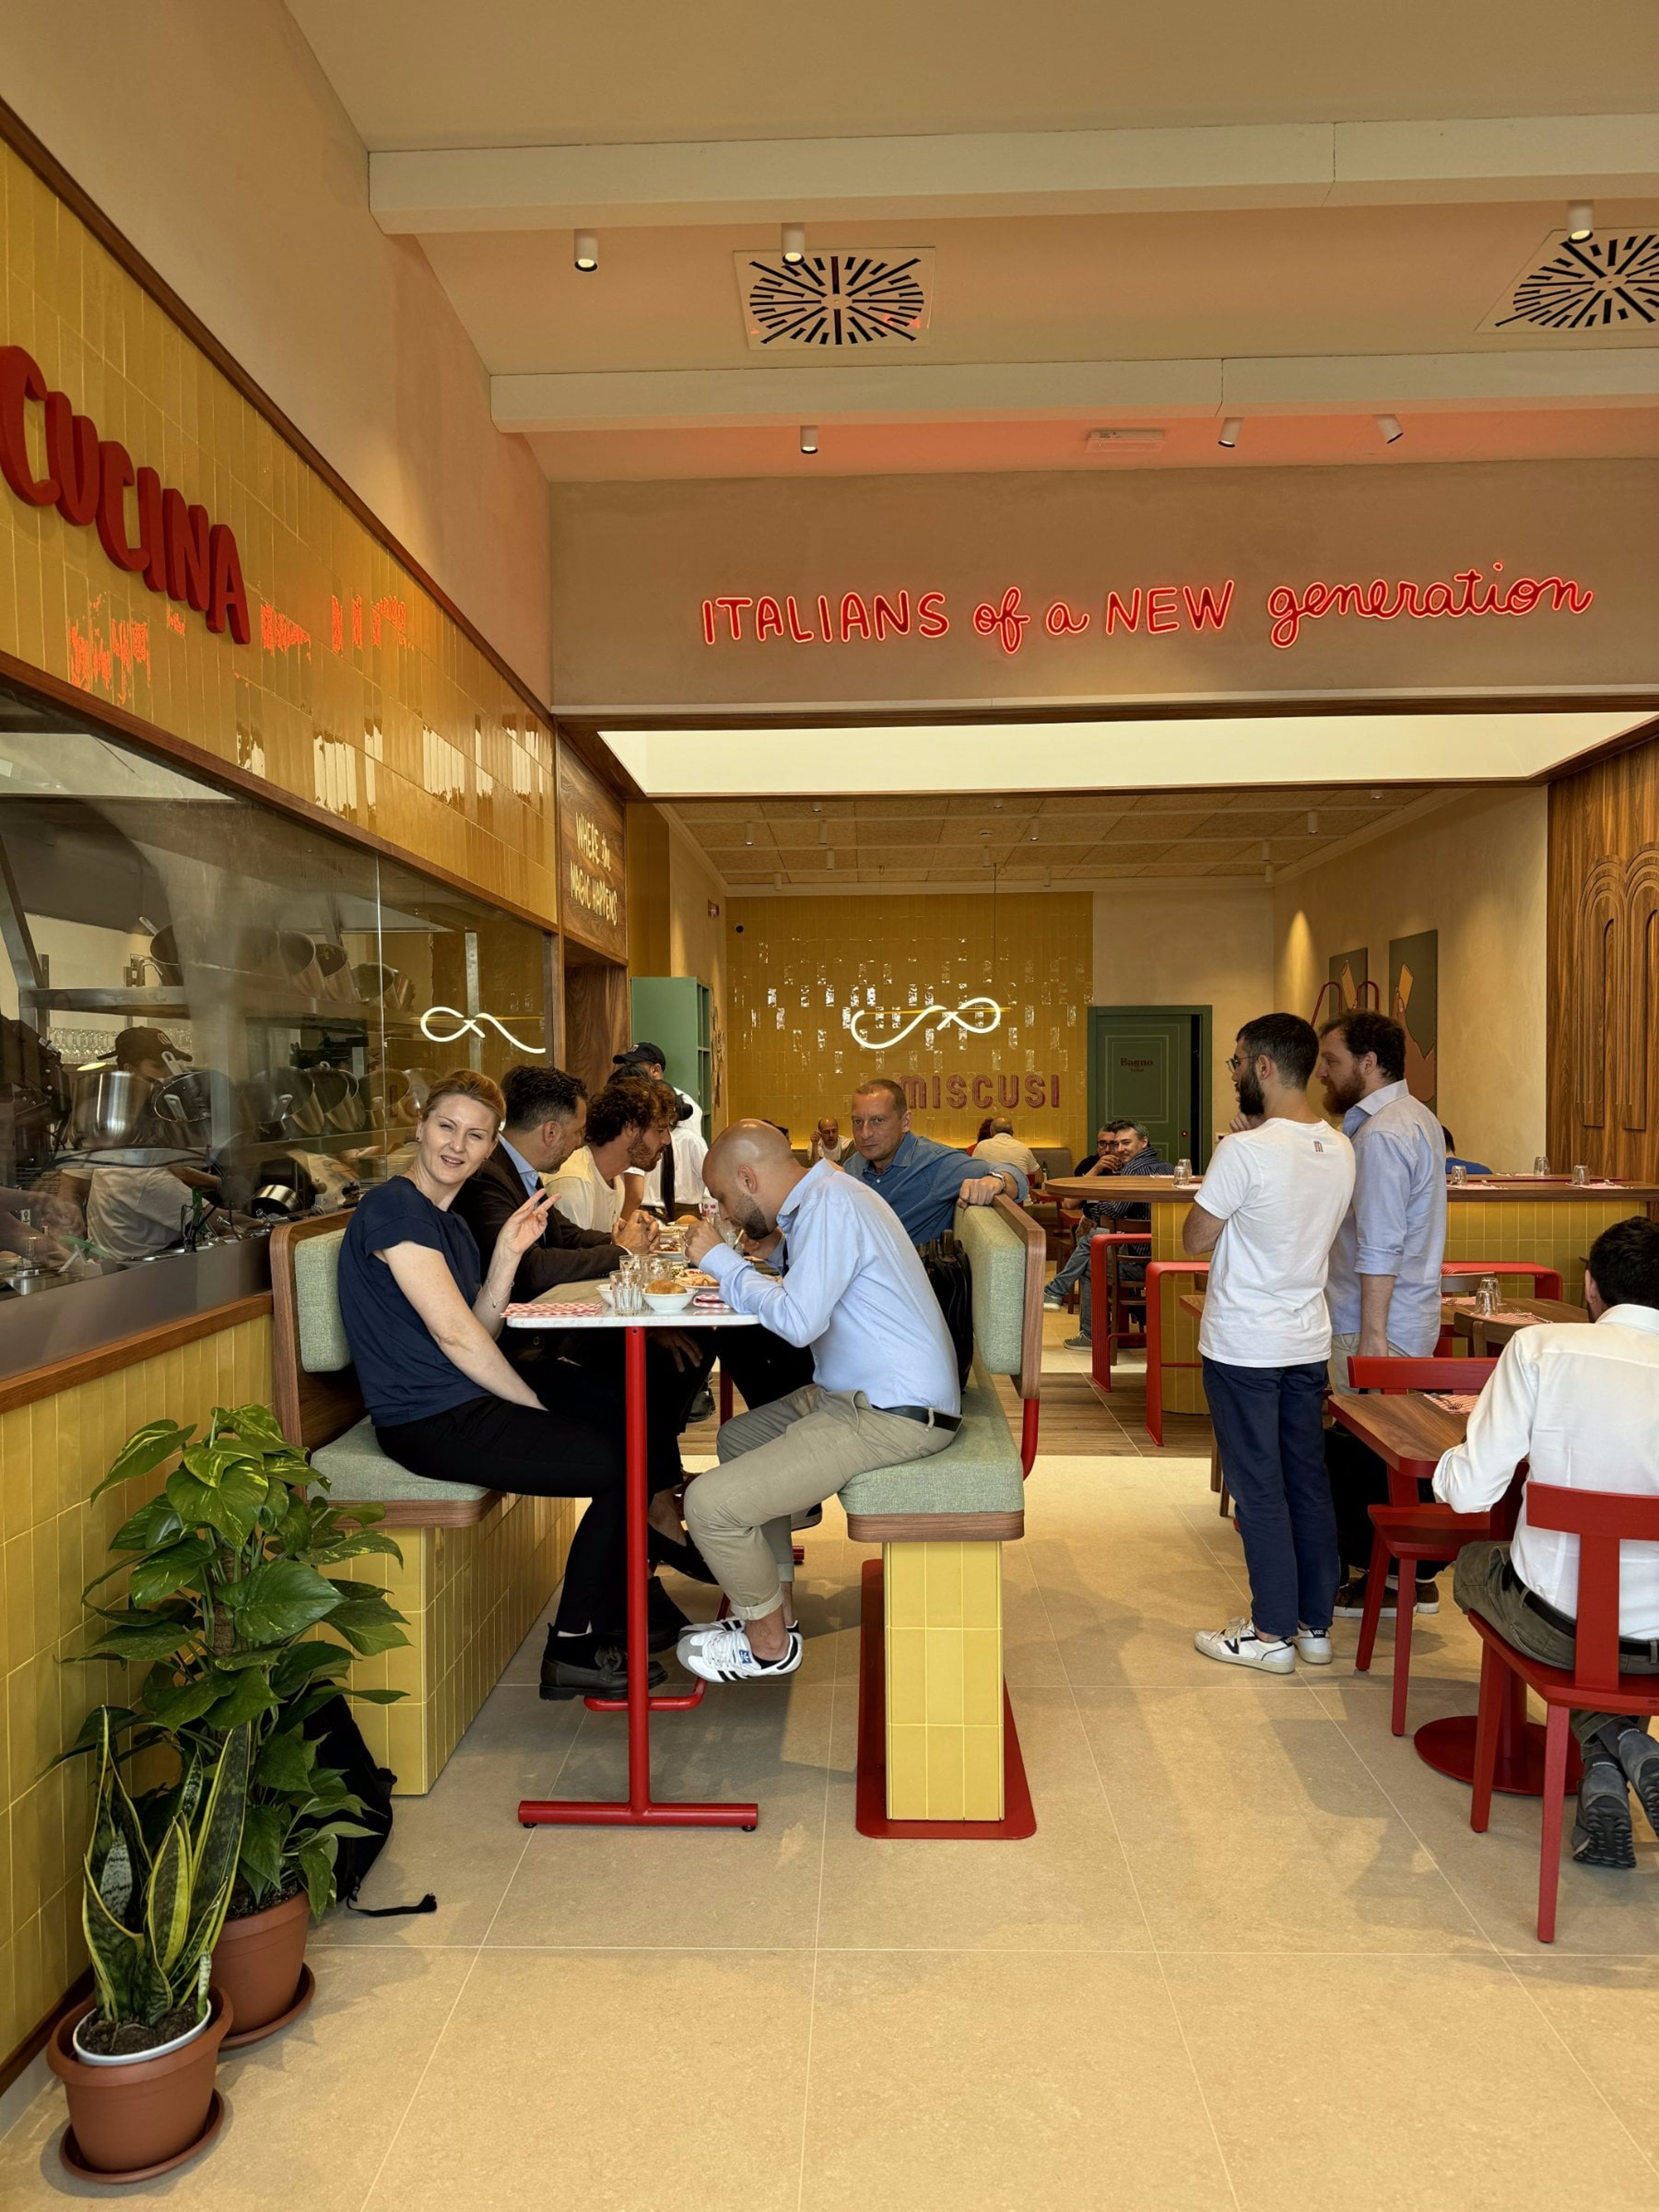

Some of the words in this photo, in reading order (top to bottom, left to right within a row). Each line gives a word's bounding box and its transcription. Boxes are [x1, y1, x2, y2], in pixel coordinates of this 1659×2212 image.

[0, 346, 251, 645] CUCINA
[702, 590, 950, 645] ITALIANS
[973, 586, 1030, 655] of
[1046, 602, 1090, 635] a
[1105, 580, 1235, 636] NEW
[1268, 562, 1594, 648] generation
[575, 811, 600, 865] WHERE
[570, 860, 591, 909] MAGIC
[592, 879, 617, 926] HAPPENS
[1120, 1058, 1154, 1067] Bagno
